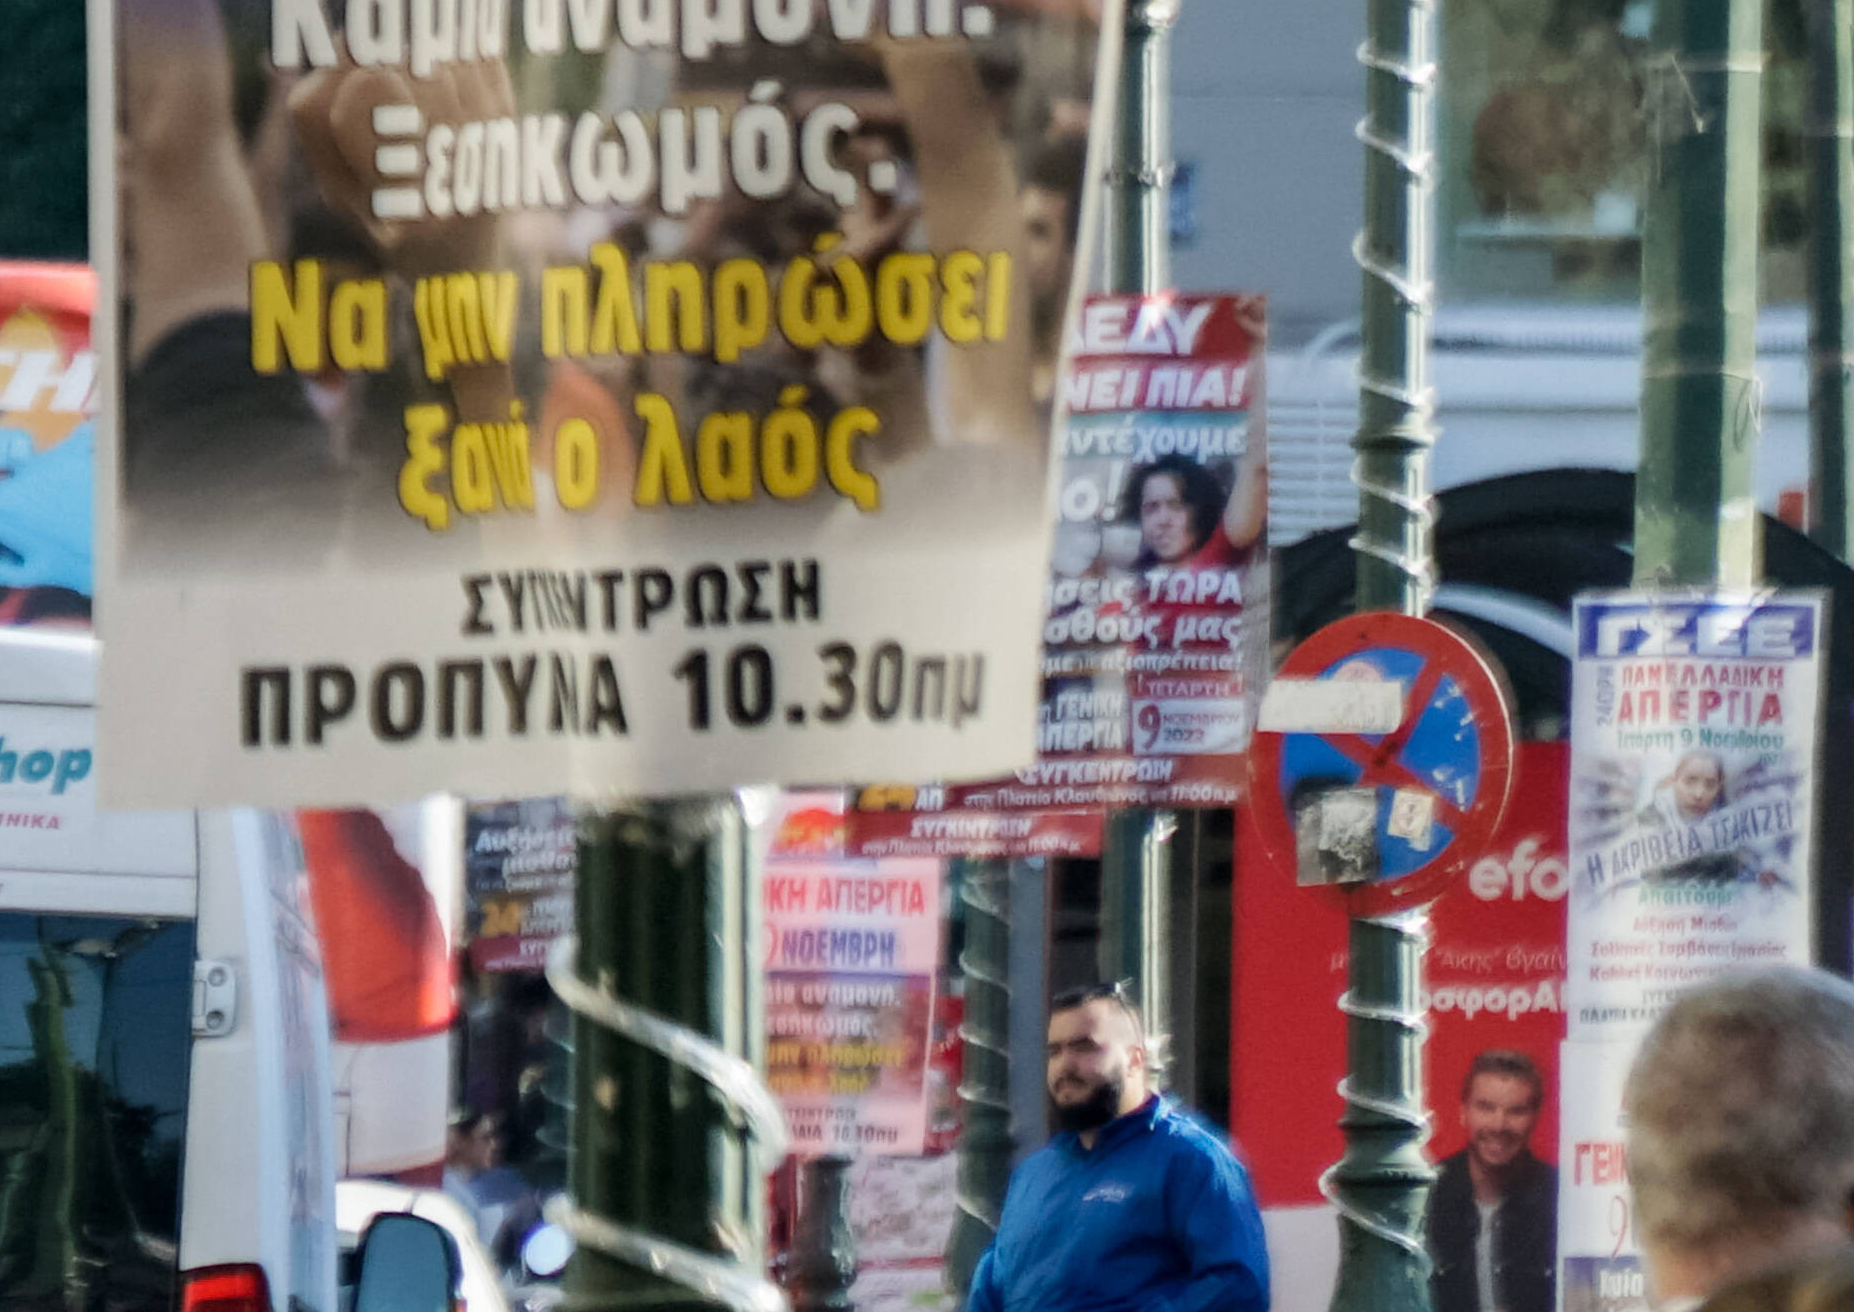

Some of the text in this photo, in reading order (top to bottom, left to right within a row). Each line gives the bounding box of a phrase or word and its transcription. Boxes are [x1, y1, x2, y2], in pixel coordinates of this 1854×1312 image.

[371, 81, 897, 222] Ξεσηκωμός.
[248, 233, 1013, 381] Να μην πληρώσει
[553, 416, 599, 512] ο
[633, 382, 882, 513] λαός
[1144, 569, 1244, 606] ΤΩΡΑ
[1172, 615, 1243, 653] μας
[1595, 611, 1797, 657] ΓΣΕΕ
[673, 639, 986, 733] 10.30πμ
[1617, 689, 1784, 726] ΑΠΕΡΓΙΑ
[1138, 703, 1162, 752] 9
[814, 877, 926, 915] ΑΠΕΡΓΙΑ
